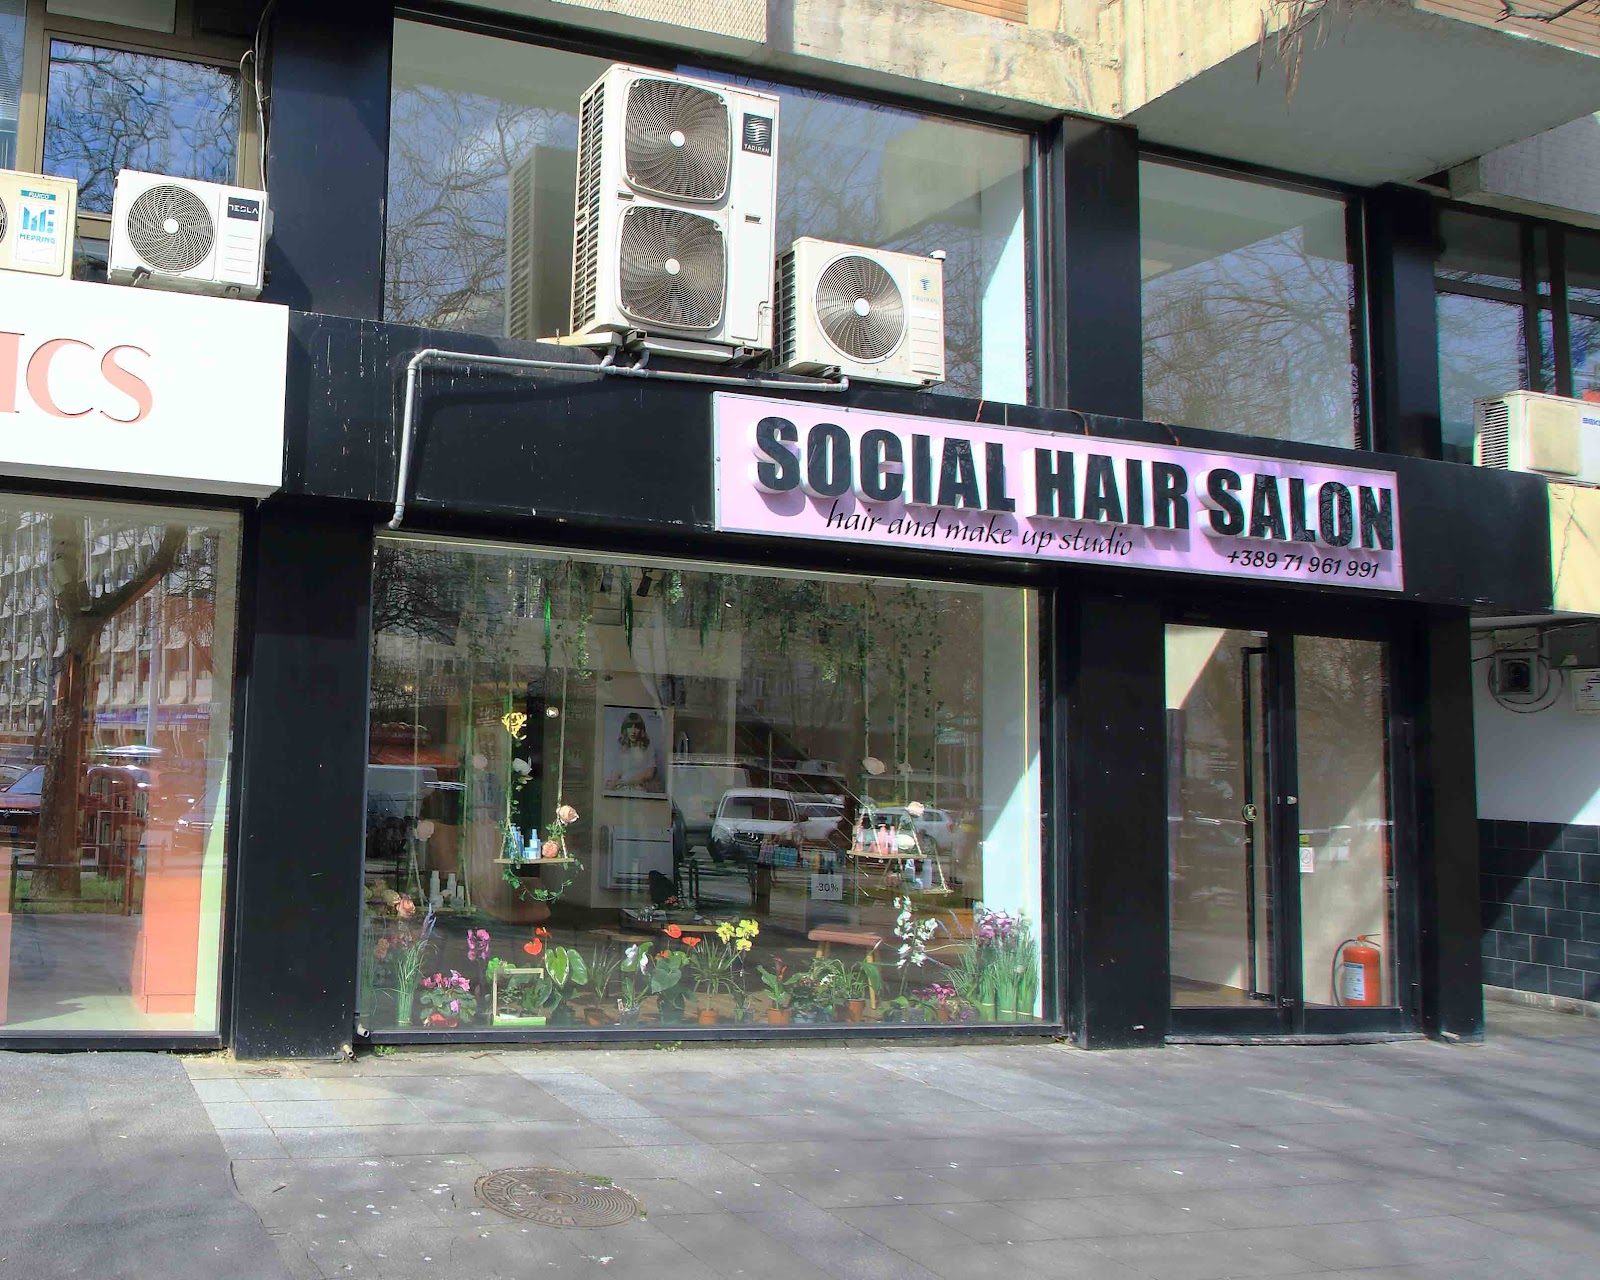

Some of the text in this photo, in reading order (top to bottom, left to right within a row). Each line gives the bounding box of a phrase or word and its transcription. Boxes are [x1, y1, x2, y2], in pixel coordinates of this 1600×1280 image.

[744, 144, 770, 154] TADIRAN
[228, 204, 259, 214] TESLA
[20, 234, 56, 244] MEPRING
[754, 416, 1394, 551] SOCIAL HAIR SALON
[826, 500, 1133, 556] hair and make up studio
[1227, 550, 1379, 578] +389 71 961 991
